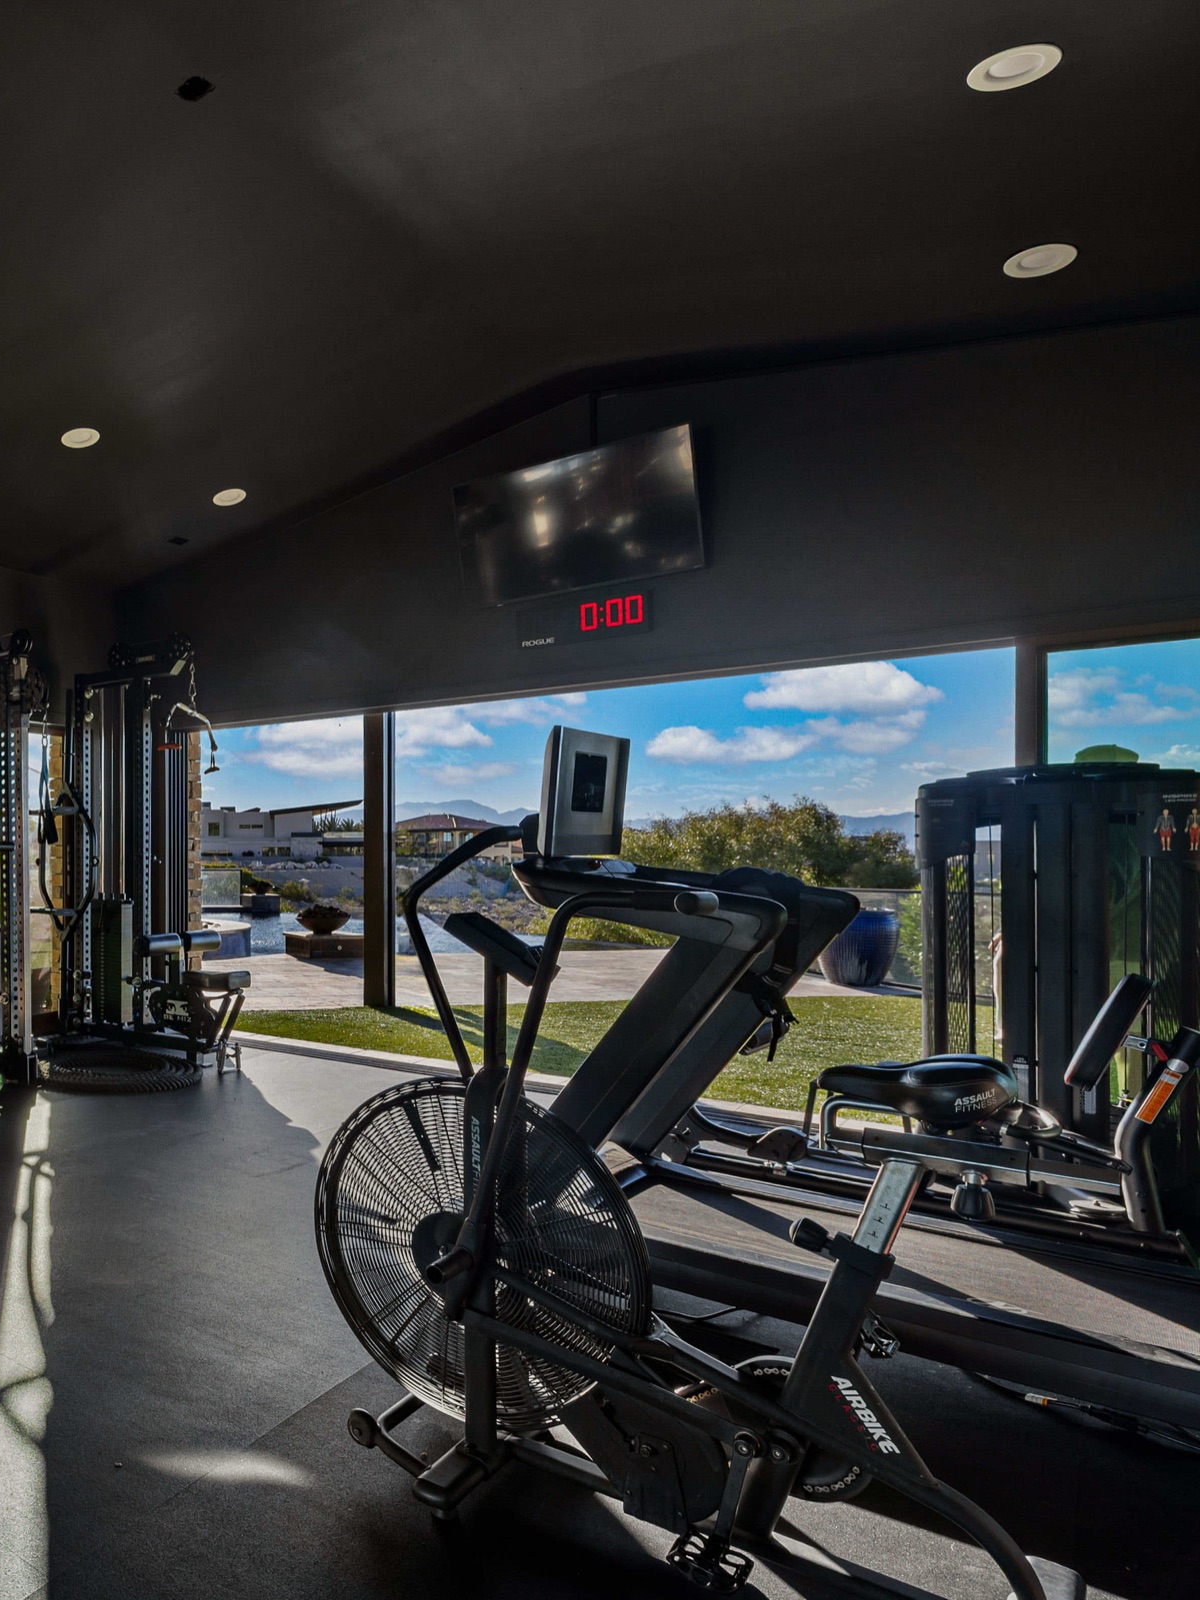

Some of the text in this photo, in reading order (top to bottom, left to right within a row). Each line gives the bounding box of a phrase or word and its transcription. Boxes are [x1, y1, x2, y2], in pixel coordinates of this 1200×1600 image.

[580, 594, 643, 632] 0:00
[521, 637, 555, 648] ROGUE
[954, 1087, 996, 1107] ASSAULT
[954, 1096, 997, 1113] FITNESS
[470, 1115, 481, 1172] ASSAULT
[827, 1383, 880, 1452] CLASSIC
[830, 1375, 901, 1454] AIRBIKE
